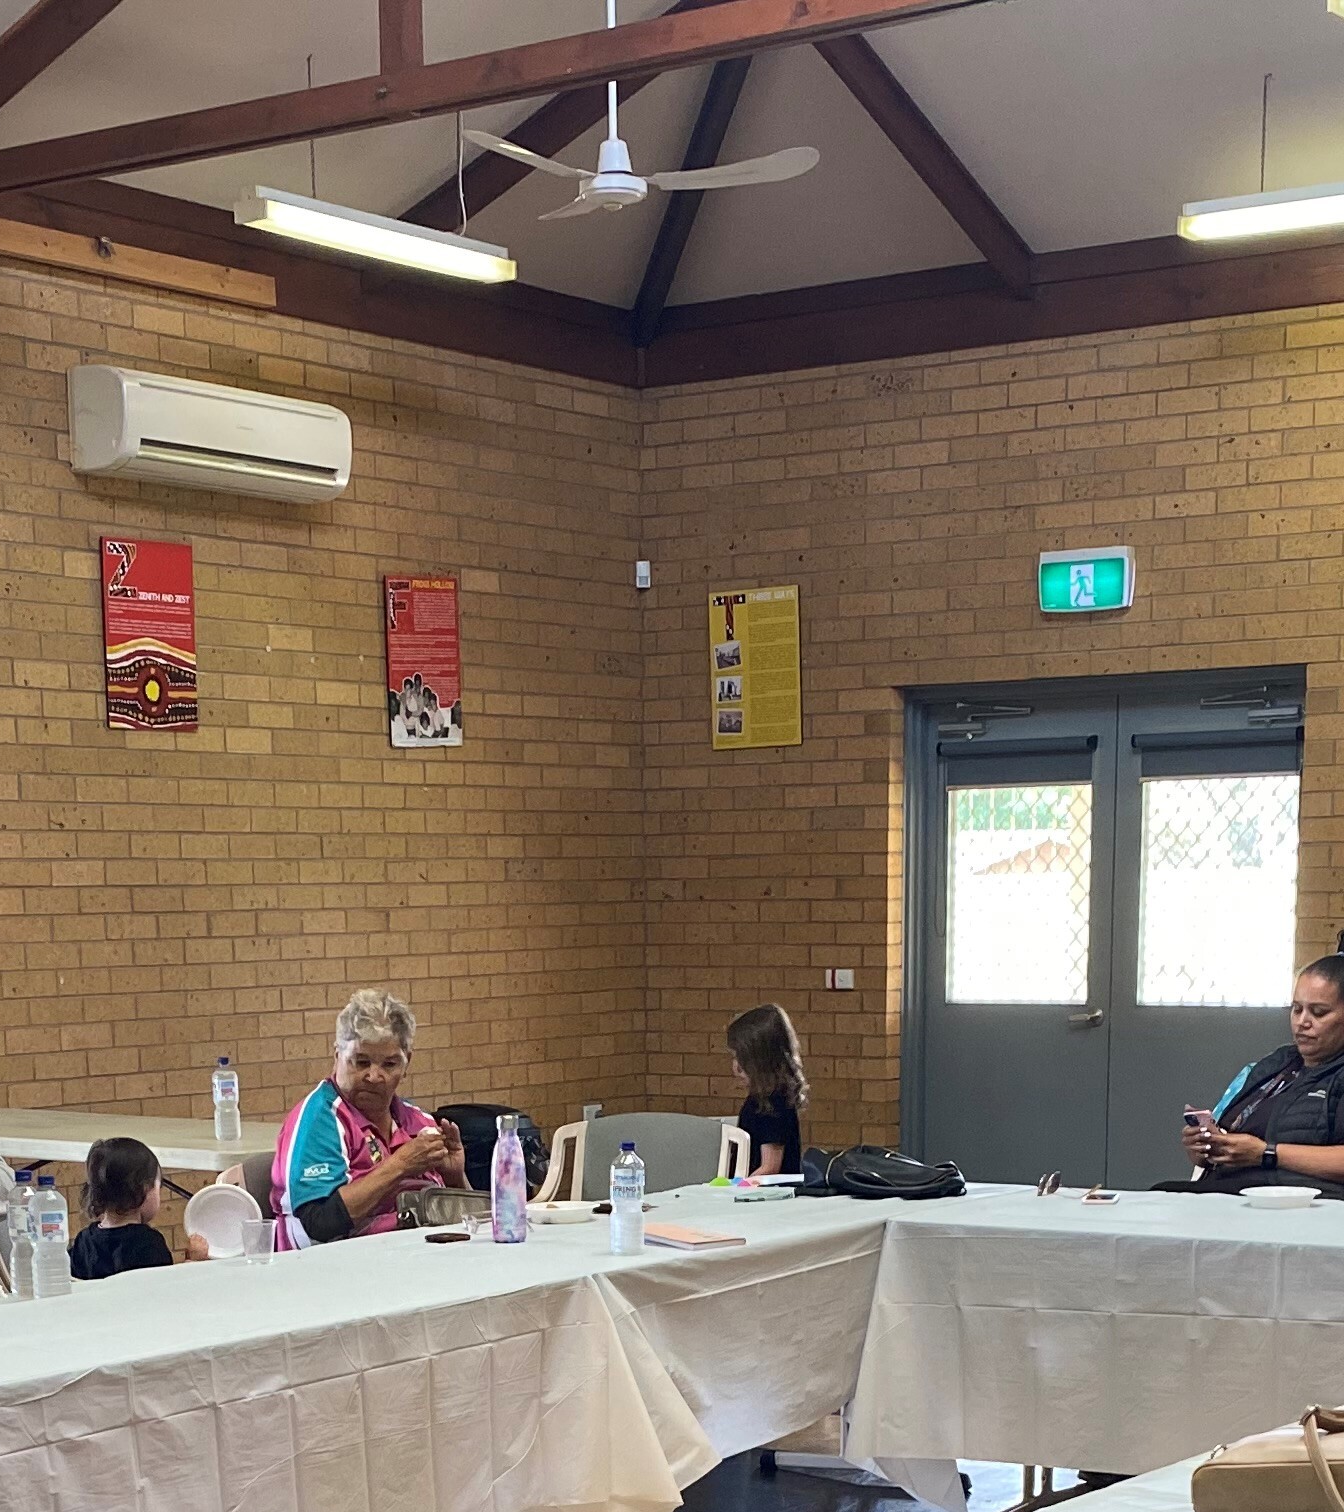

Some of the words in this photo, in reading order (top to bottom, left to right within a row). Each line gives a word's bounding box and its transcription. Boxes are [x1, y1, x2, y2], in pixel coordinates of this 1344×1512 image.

[106, 541, 137, 599] Z
[138, 591, 160, 601] ZENITH
[161, 594, 174, 602] AND
